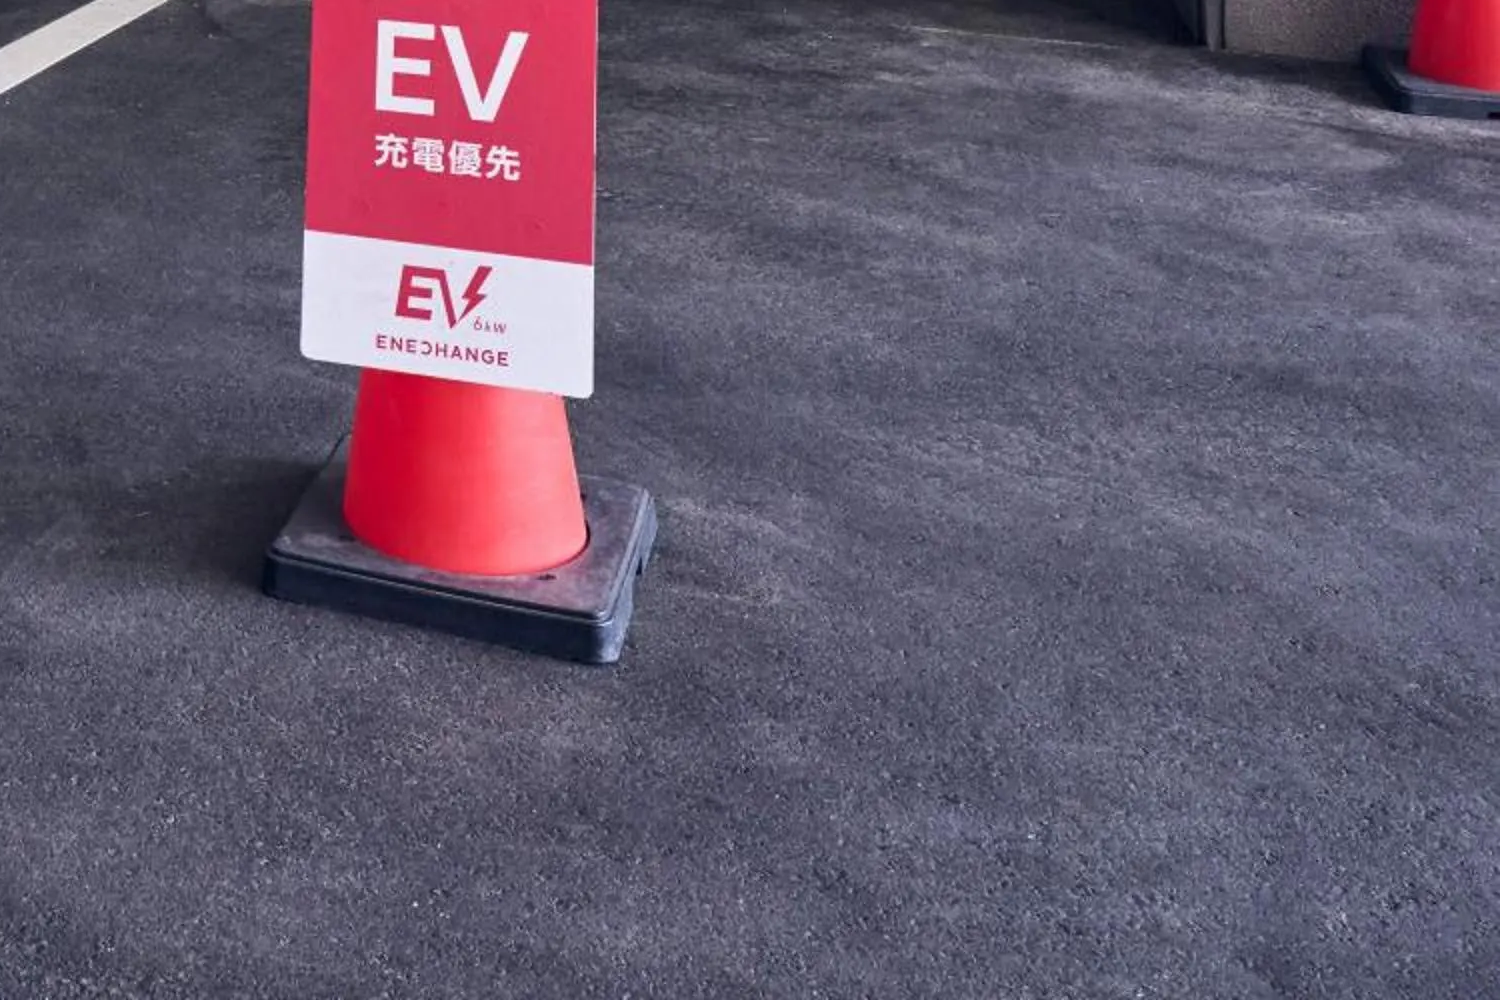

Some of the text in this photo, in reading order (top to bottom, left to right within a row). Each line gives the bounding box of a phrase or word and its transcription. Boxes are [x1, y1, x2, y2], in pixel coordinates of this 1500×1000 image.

[374, 19, 529, 122] EV
[375, 133, 521, 181] 充電優先
[394, 264, 493, 329] EV
